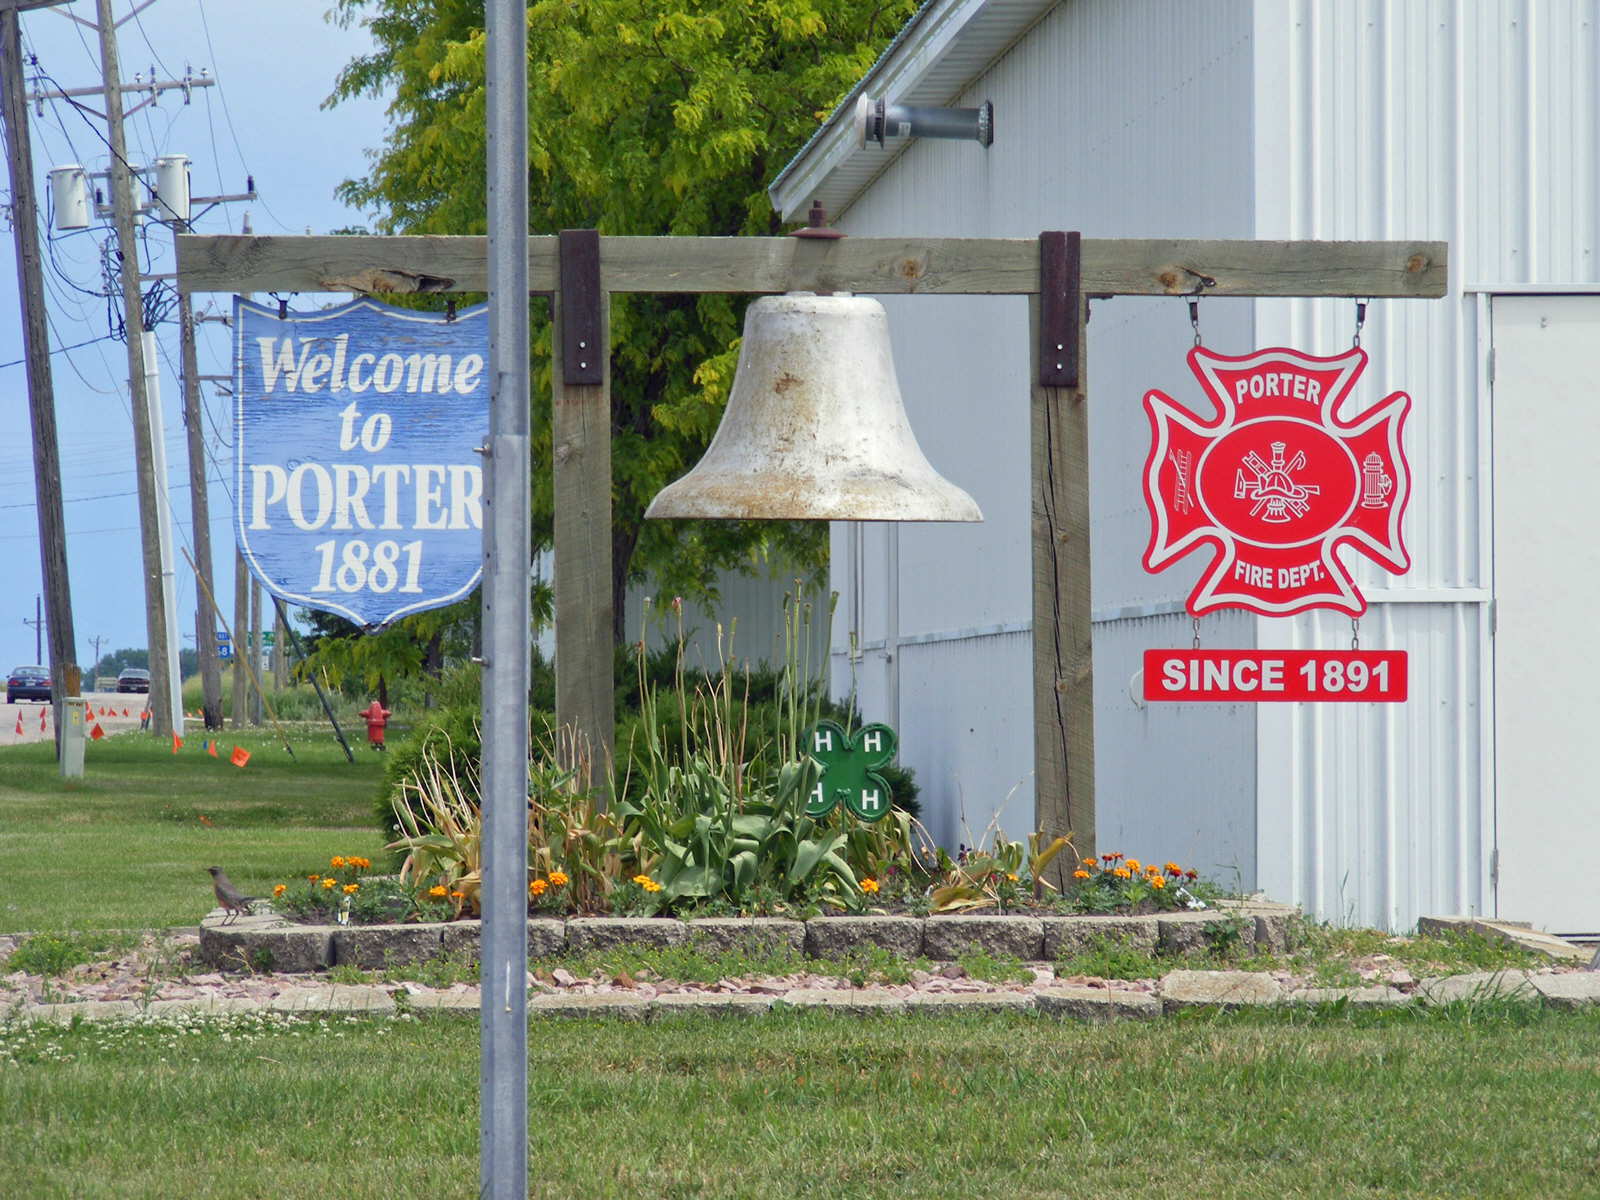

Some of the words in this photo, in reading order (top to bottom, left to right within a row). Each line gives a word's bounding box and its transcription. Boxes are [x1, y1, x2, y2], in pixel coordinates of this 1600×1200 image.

[256, 333, 484, 394] Welcome
[1235, 372, 1322, 406] PORTER
[338, 401, 392, 452] to
[248, 463, 483, 530] PORTER
[310, 539, 423, 593] 1881
[1234, 560, 1273, 589] FIRE
[1278, 560, 1325, 589] DEPT.
[1161, 659, 1285, 692] SINCE
[1299, 660, 1389, 693] 1891
[814, 730, 832, 752] H
[863, 731, 881, 752] H
[862, 789, 879, 810] H
